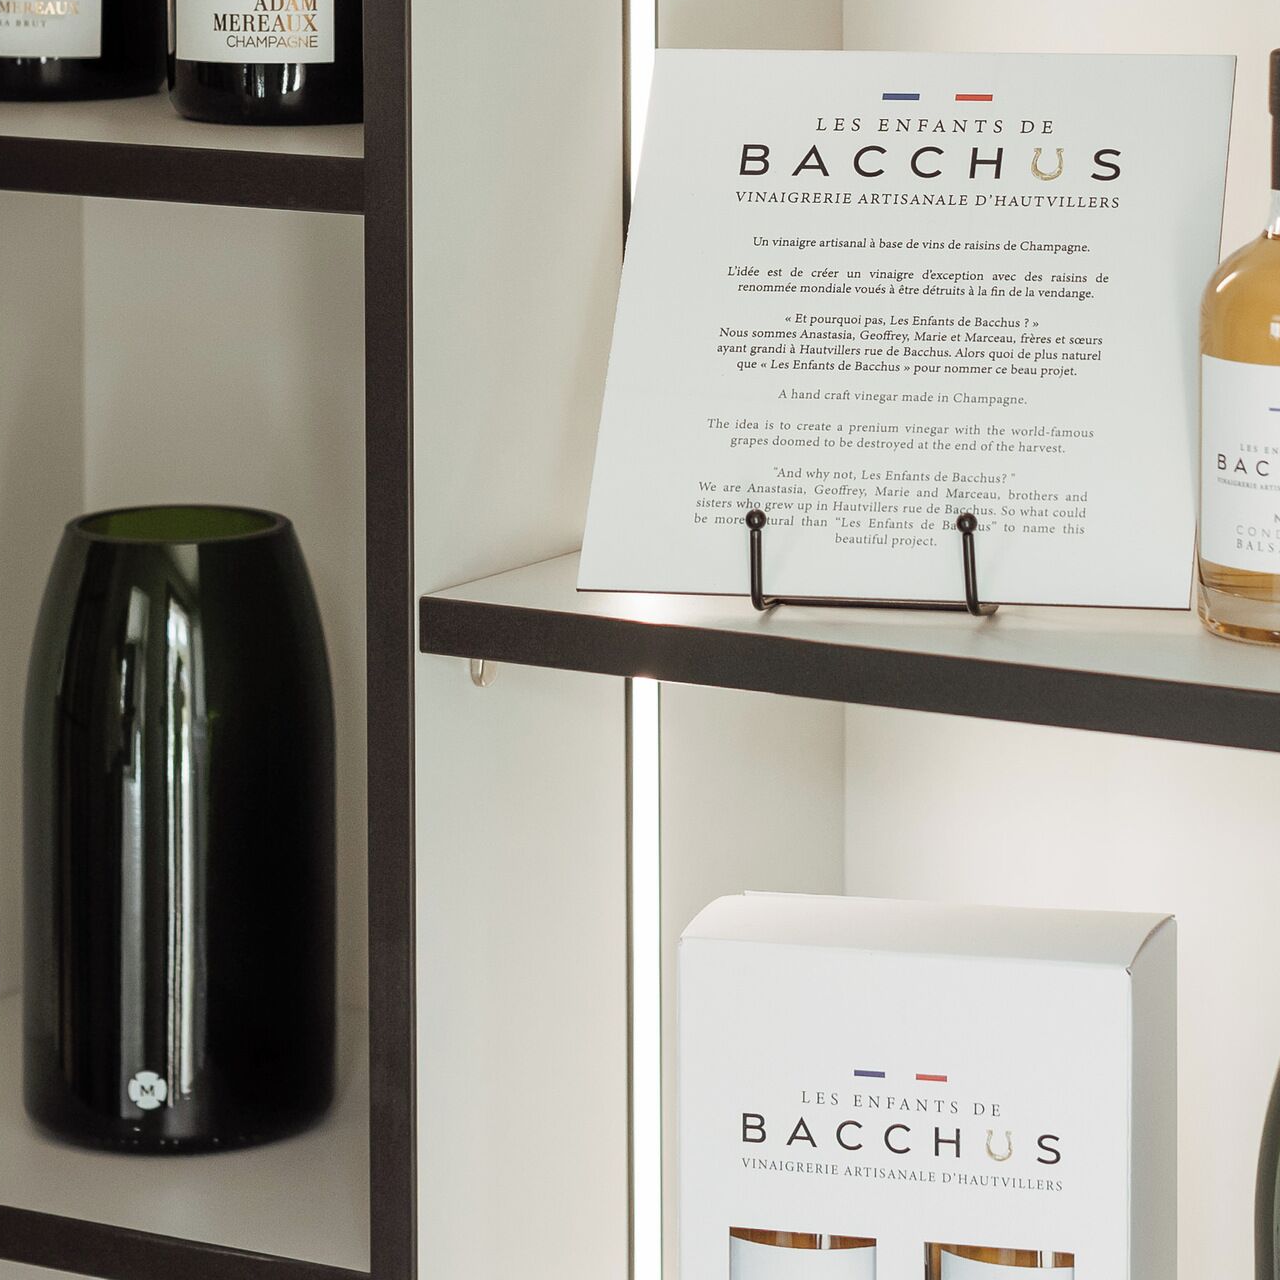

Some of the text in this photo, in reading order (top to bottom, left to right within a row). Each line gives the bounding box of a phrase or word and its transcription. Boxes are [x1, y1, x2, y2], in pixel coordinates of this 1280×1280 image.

[213, 13, 318, 32] MEREAUX
[226, 35, 318, 48] CHAMPAGNE
[816, 117, 1055, 135] LES ENFANTS DE
[735, 191, 852, 205] VINAIGRERIE
[858, 193, 969, 207] ARTISANALE
[753, 235, 768, 246] Un
[772, 236, 816, 249] vinaigre
[819, 236, 866, 247] artisanal
[878, 237, 902, 248] base
[905, 238, 919, 248] de
[922, 238, 944, 249] vins
[947, 238, 961, 249] de
[964, 239, 1000, 250] raisins
[1003, 239, 1016, 250] de
[1019, 240, 1090, 255] Champagne.
[767, 267, 782, 276] est
[790, 266, 803, 277] de
[810, 266, 839, 278] créer
[846, 270, 861, 278] un
[868, 268, 914, 282] vinaigre
[992, 272, 1016, 281] avec
[1024, 270, 1042, 281] des
[1050, 271, 1087, 282] raisins
[1095, 271, 1108, 282] de
[737, 280, 796, 292] renommée
[800, 281, 852, 293] mondiale
[854, 282, 886, 294] voués
[898, 283, 919, 294] être
[922, 284, 965, 295] détruits
[977, 284, 987, 296] la
[990, 285, 1005, 296] fin
[1008, 285, 1022, 296] de
[1025, 286, 1034, 296] la
[1038, 286, 1094, 301] vendange.
[794, 312, 1020, 327] Et pourquoi pas, Les Enfants de Bacchus
[719, 326, 1102, 345] Nous sommes Anastasia, Geoffrey, Marie et Marceau, frères et sœurs
[716, 343, 746, 355] ayant
[749, 342, 786, 356] grandi
[799, 343, 860, 355] Hautvillers
[864, 347, 882, 355] rue
[886, 344, 899, 356] de
[903, 345, 951, 357] Bacchus.
[954, 346, 985, 358] Alors
[988, 348, 1014, 361] quoi
[1017, 347, 1030, 359] de
[1034, 348, 1058, 362] plus
[1061, 349, 1101, 360] naturel
[736, 358, 1076, 378] que Les Enfants de Bacchus pour nommer ce beau projet.
[790, 387, 820, 399] hand
[824, 388, 850, 400] craft
[854, 390, 898, 404] vinegar
[902, 390, 933, 402] made
[937, 391, 949, 402] in
[952, 391, 1027, 407] Champagne.
[1240, 443, 1258, 453] LES
[801, 1089, 1001, 1117] LES ENFANTS DE
[742, 1157, 839, 1176] VINAIGRERIE
[844, 1166, 936, 1184] ARTISANALE
